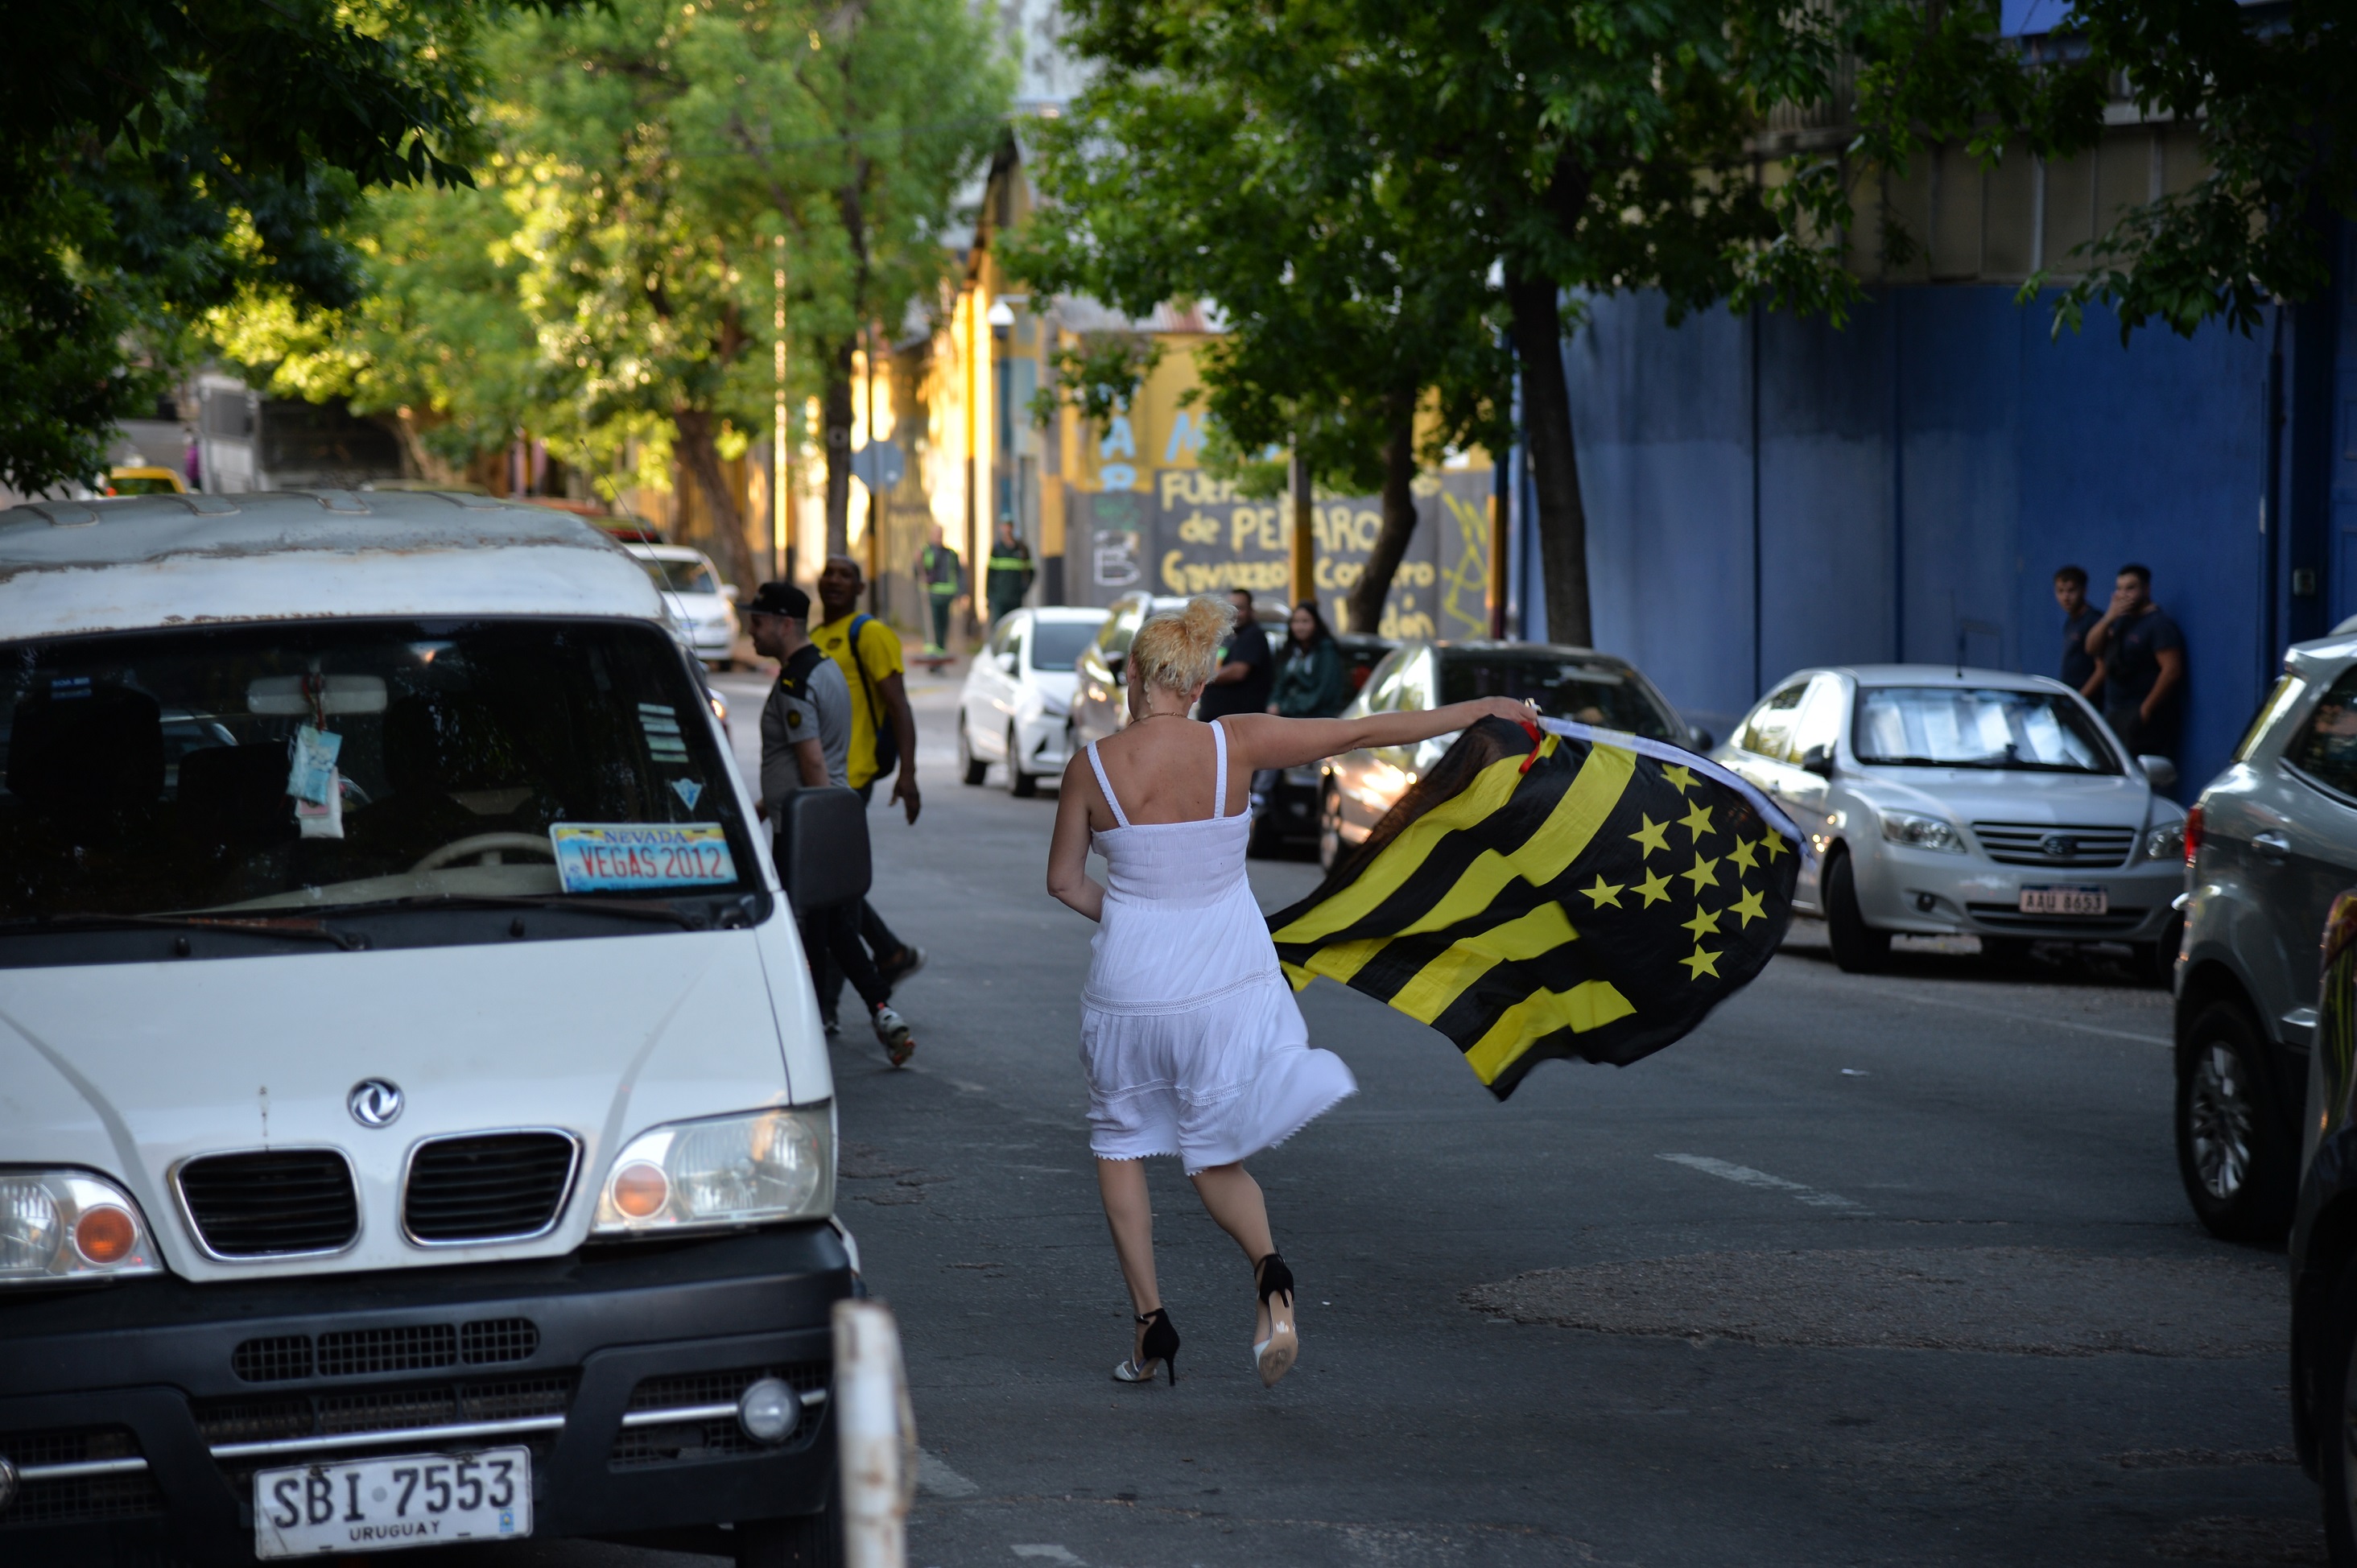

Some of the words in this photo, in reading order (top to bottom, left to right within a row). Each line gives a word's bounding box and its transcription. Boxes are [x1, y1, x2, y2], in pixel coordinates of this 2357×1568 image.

[1178, 510, 1221, 545] de
[1230, 490, 1385, 553] PEARO
[603, 830, 687, 844] NEVADA
[580, 847, 658, 878] VEGAS
[660, 847, 725, 878] 2012
[273, 1468, 365, 1529] SBI
[393, 1459, 514, 1517] 7553
[349, 1520, 441, 1542] URUGUAY
